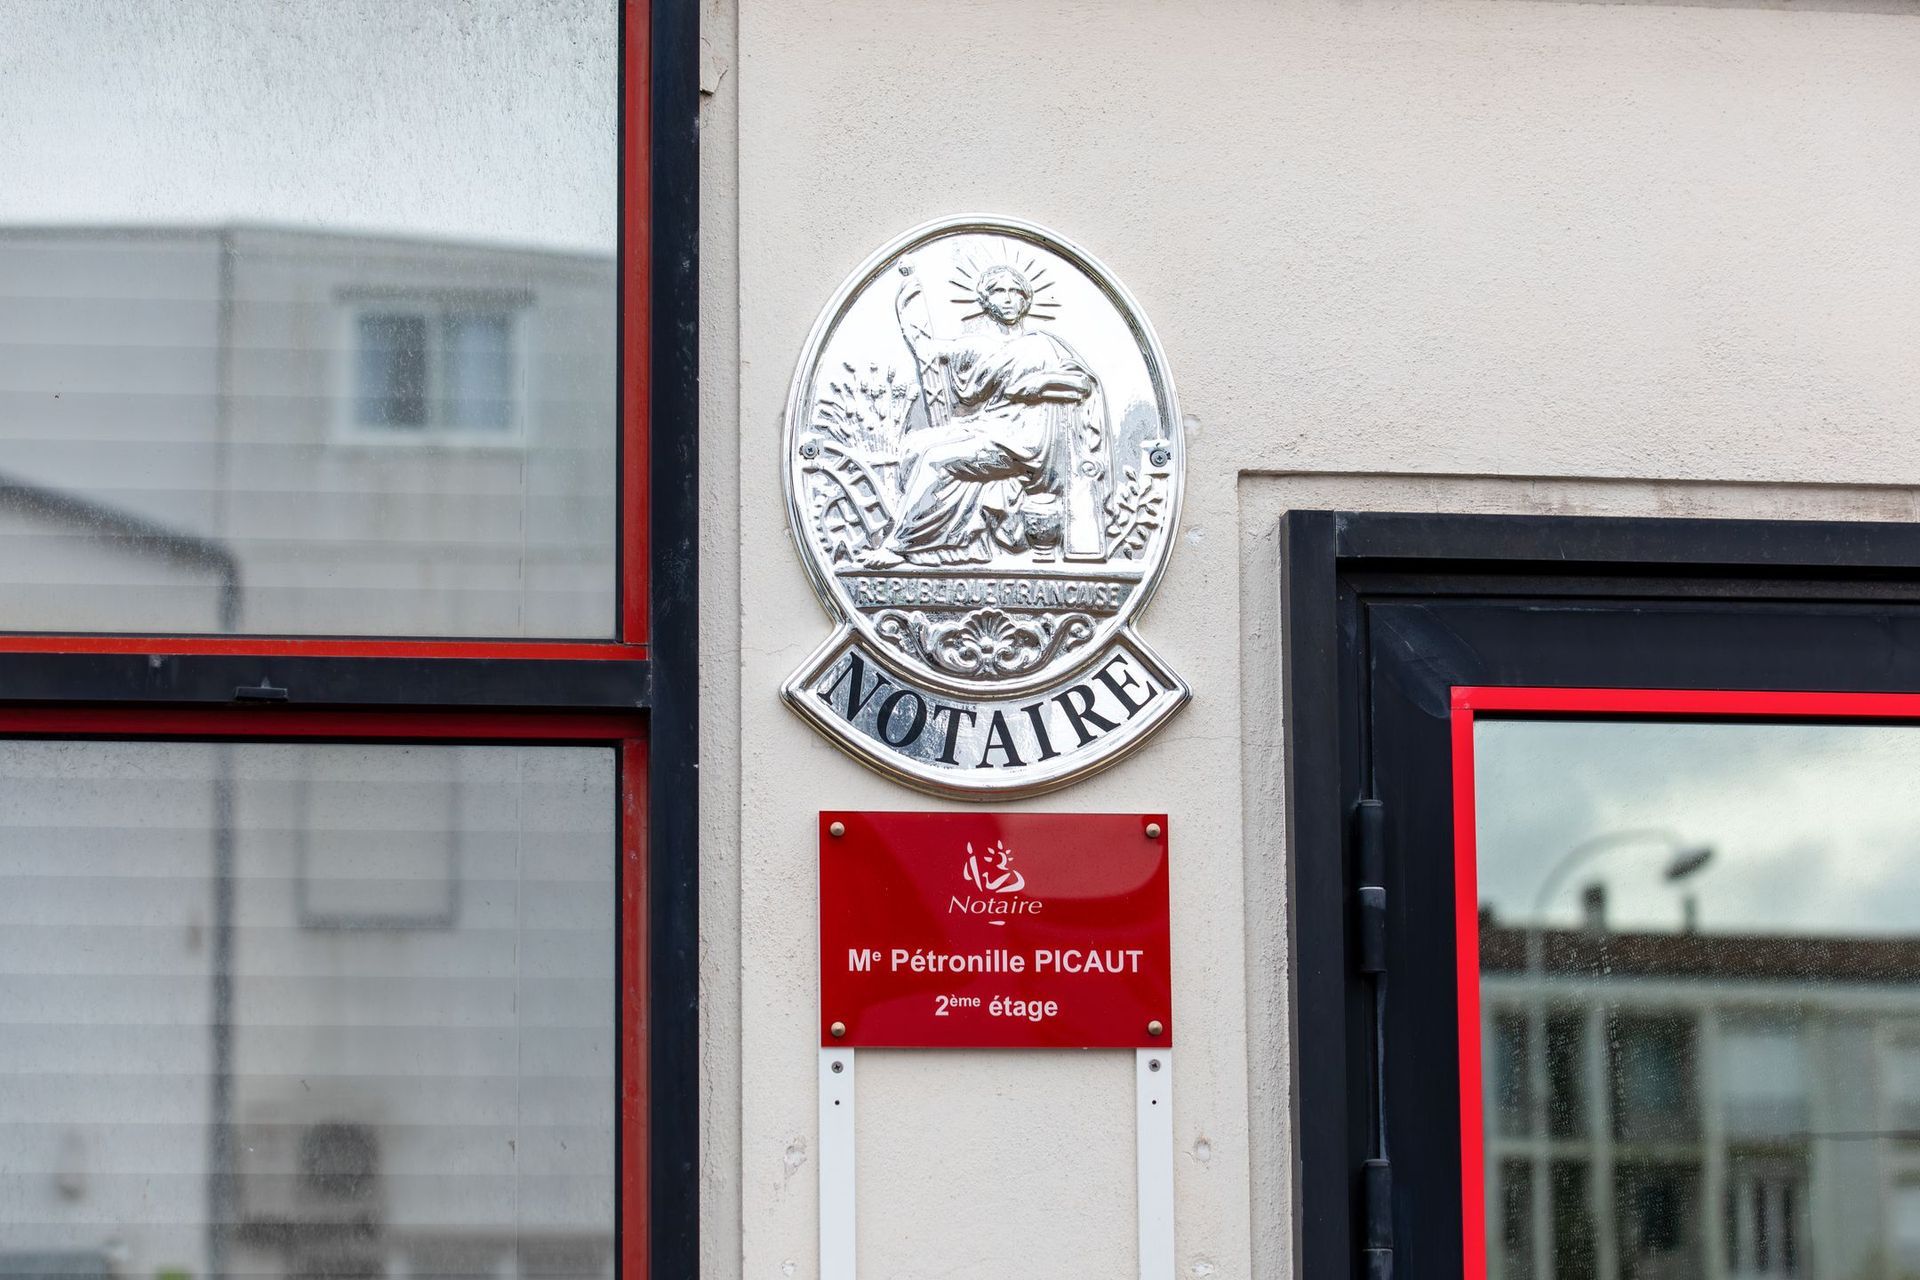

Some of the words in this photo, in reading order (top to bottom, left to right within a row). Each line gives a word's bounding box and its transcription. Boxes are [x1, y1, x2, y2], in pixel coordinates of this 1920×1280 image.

[817, 651, 1158, 768] NOTAIRE
[948, 895, 1043, 914] Notaire
[848, 948, 882, 972] Me
[891, 948, 1025, 973] Pétronille
[1035, 949, 1144, 973] PICAUT
[935, 994, 981, 1016] 2ème
[988, 995, 1058, 1021] étage
